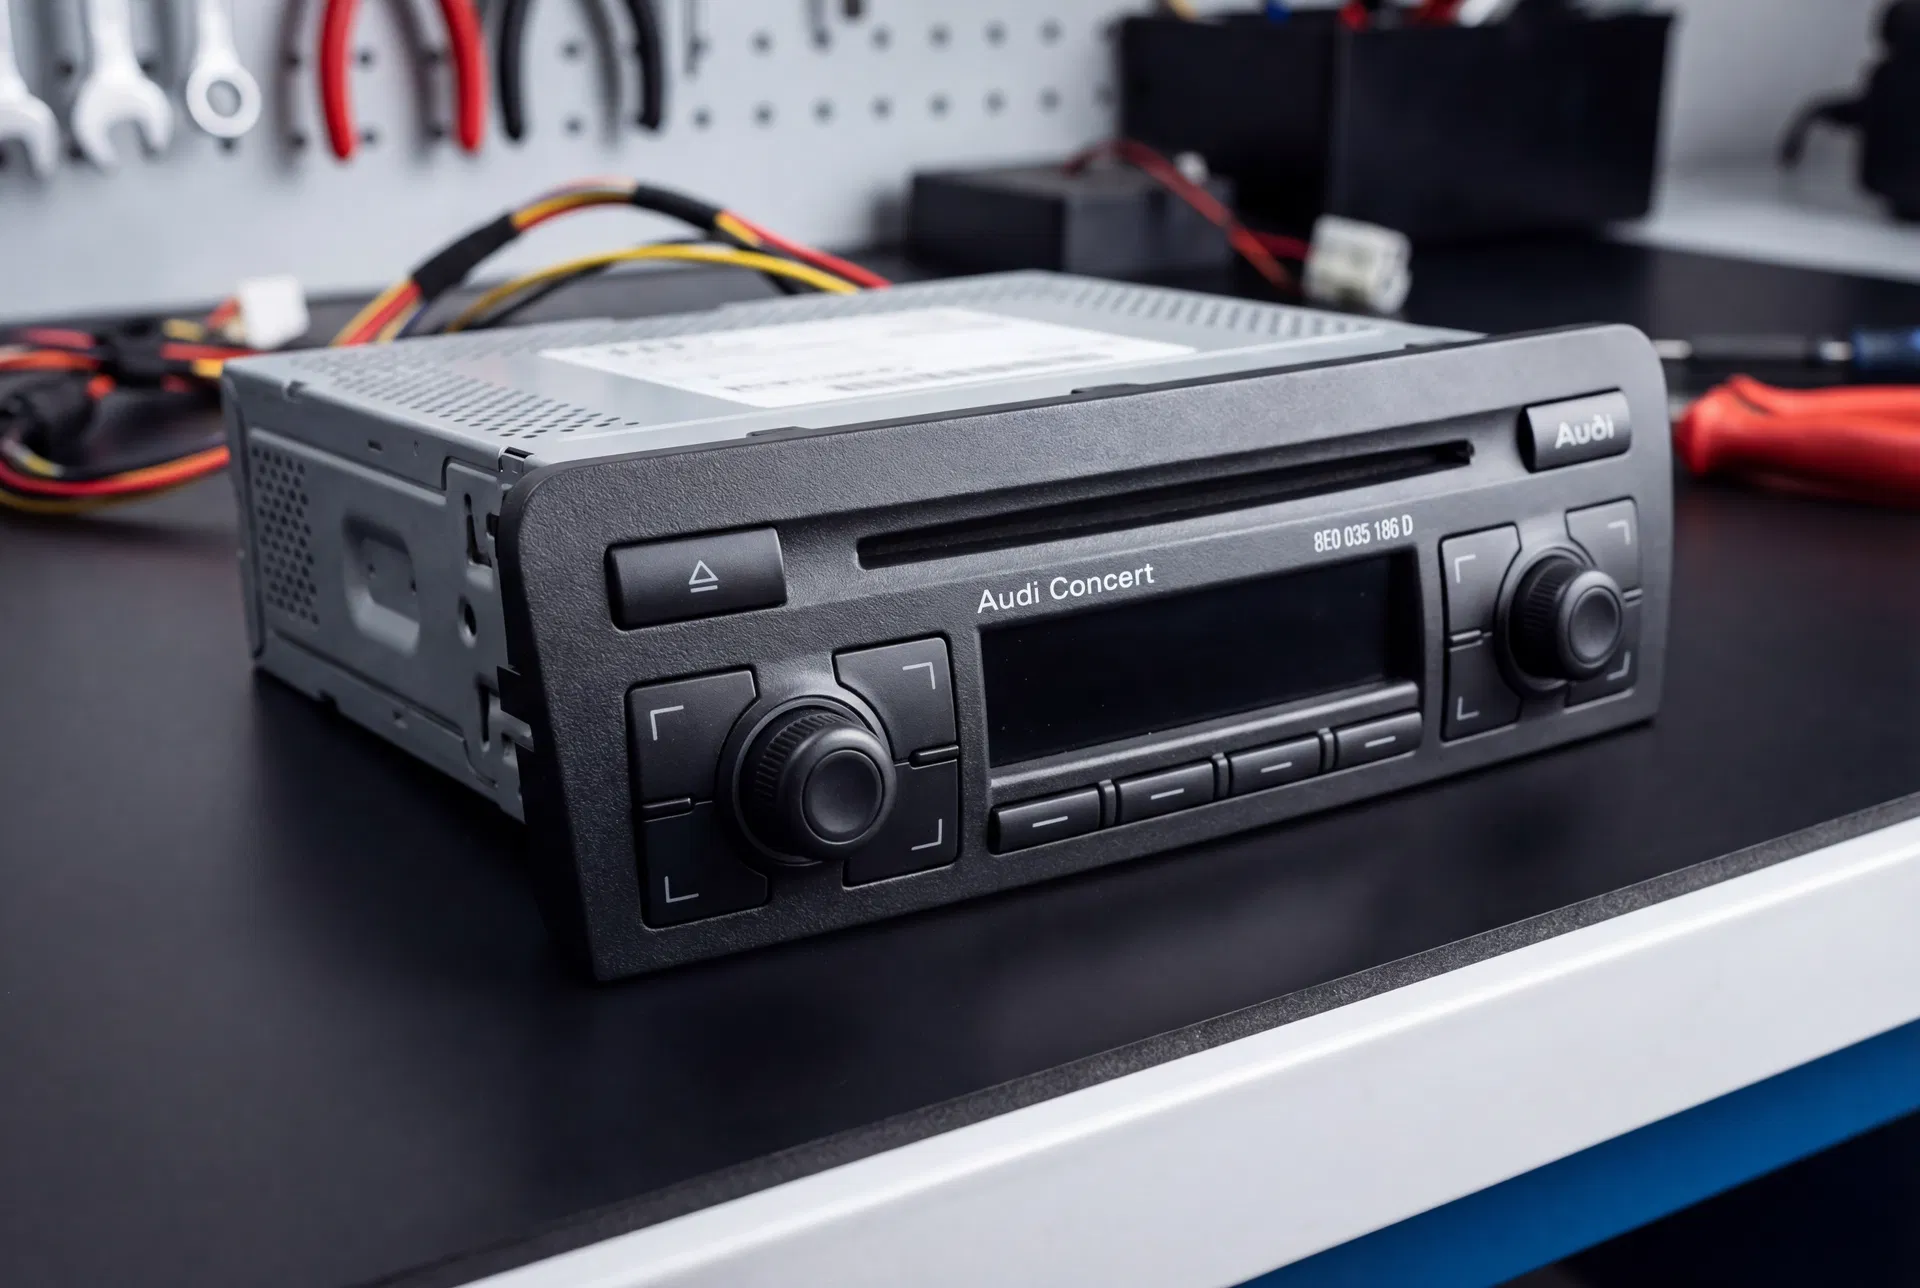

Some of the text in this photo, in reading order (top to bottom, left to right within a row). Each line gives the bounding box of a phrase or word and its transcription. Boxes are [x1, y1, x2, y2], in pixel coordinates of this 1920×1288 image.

[1554, 413, 1615, 449] Audi
[1313, 514, 1414, 553] 8E0 035 186 D
[977, 563, 1155, 614] Audi Concert
